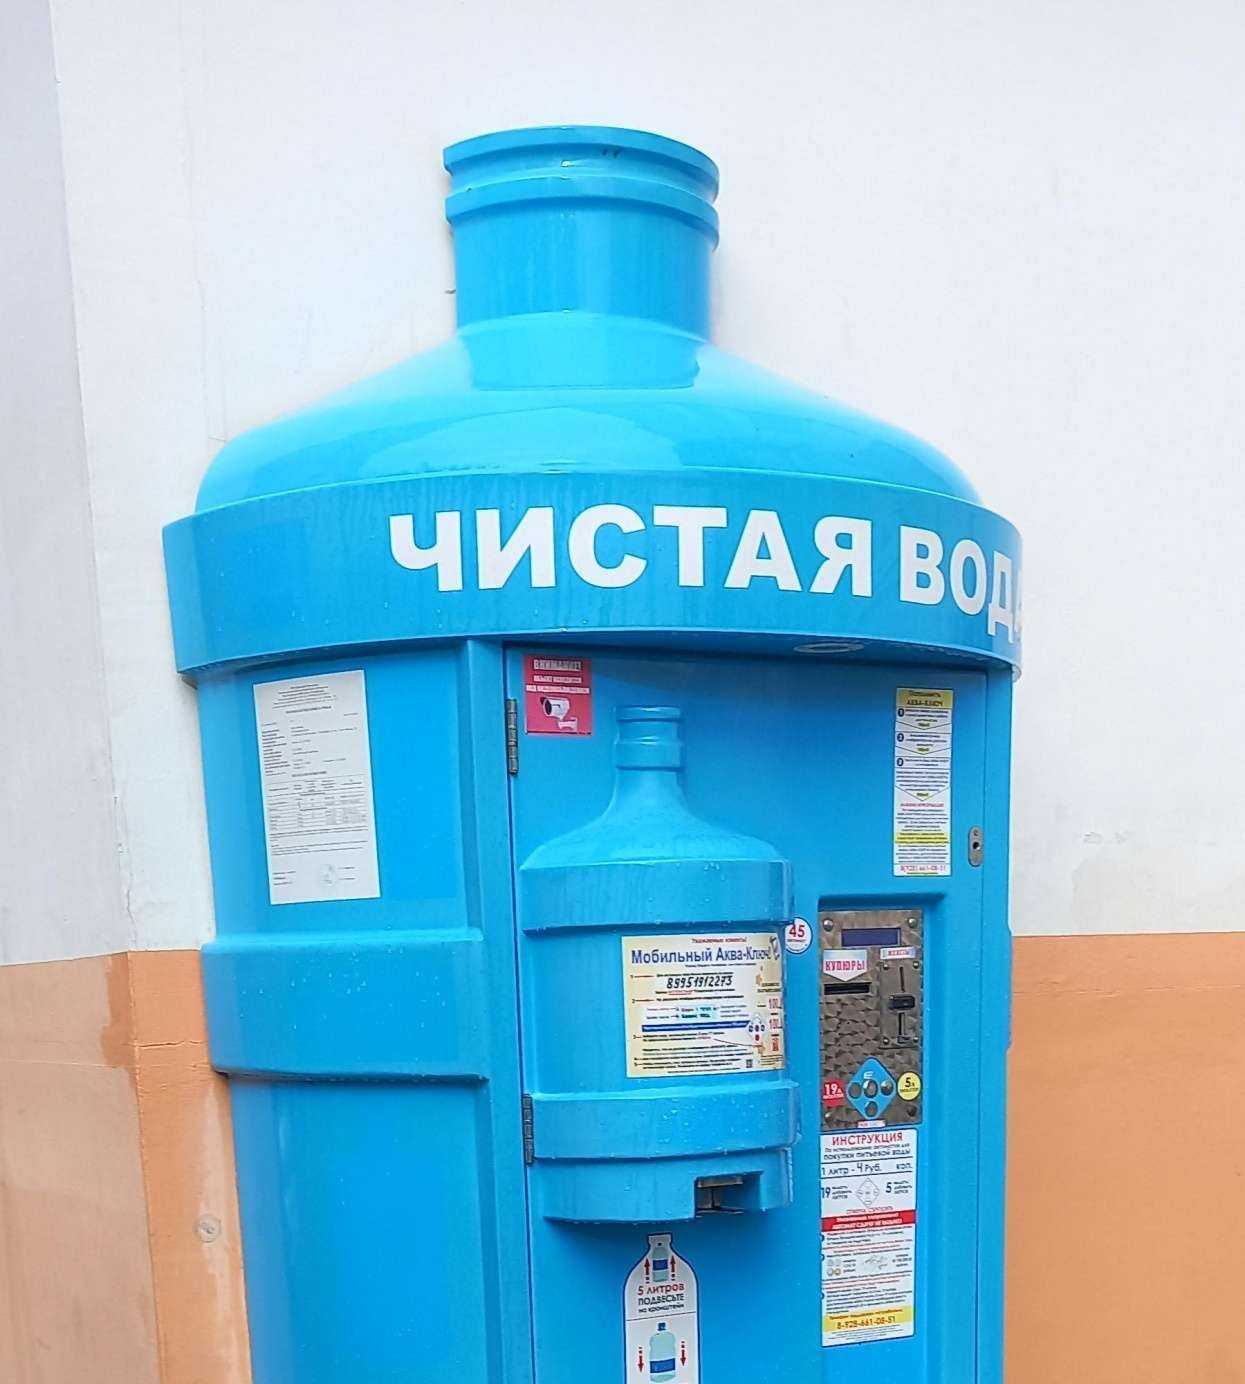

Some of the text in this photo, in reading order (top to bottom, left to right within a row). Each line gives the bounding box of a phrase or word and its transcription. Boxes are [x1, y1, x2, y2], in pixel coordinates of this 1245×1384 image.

[389, 504, 1021, 643] ЧИСТАЯ ВОД
[789, 924, 805, 937] 45
[631, 946, 713, 964] Мобильный
[825, 960, 865, 971] КУПЮРЫ
[832, 1132, 903, 1146] ИНСТРУКЦИЯ
[821, 1186, 831, 1199] 19
[885, 1181, 892, 1193] 5
[638, 1283, 685, 1295] 5 литров
